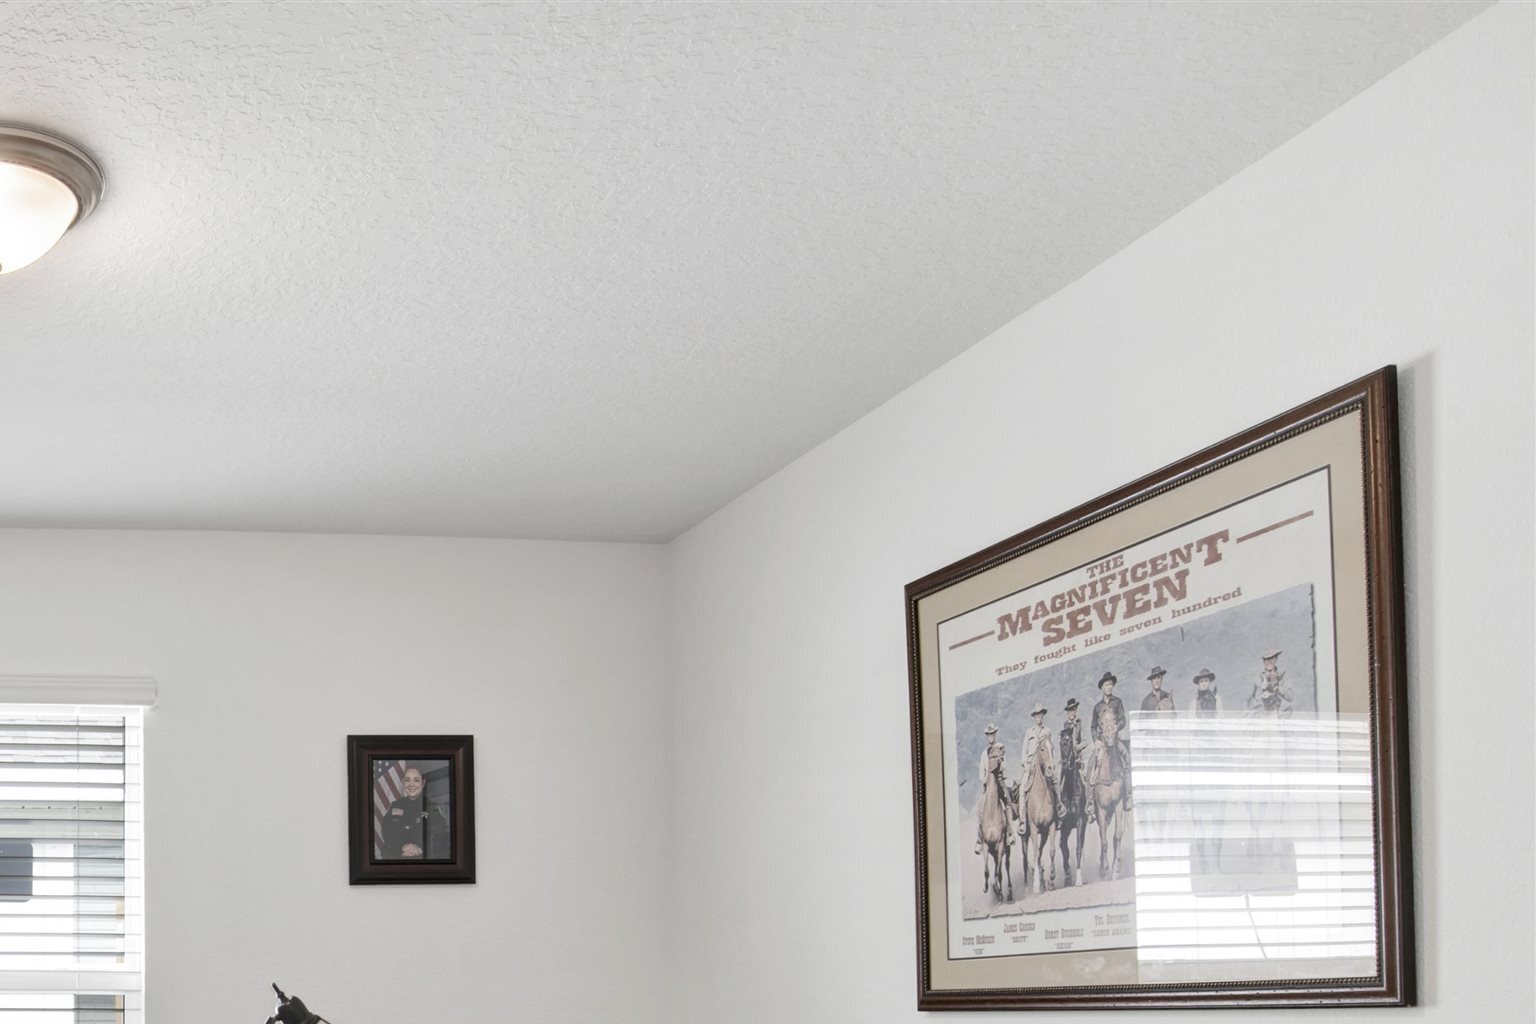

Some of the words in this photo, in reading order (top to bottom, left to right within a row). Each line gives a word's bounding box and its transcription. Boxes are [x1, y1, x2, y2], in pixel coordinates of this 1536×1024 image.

[996, 528, 1230, 642] MAGNIFICENT
[1041, 568, 1190, 647] SEVEN
[1086, 555, 1125, 579] THE
[995, 660, 1028, 677] They
[1033, 643, 1077, 665] fought
[1084, 632, 1112, 648] like
[1119, 616, 1163, 637] seven
[1170, 587, 1243, 619] hundred
